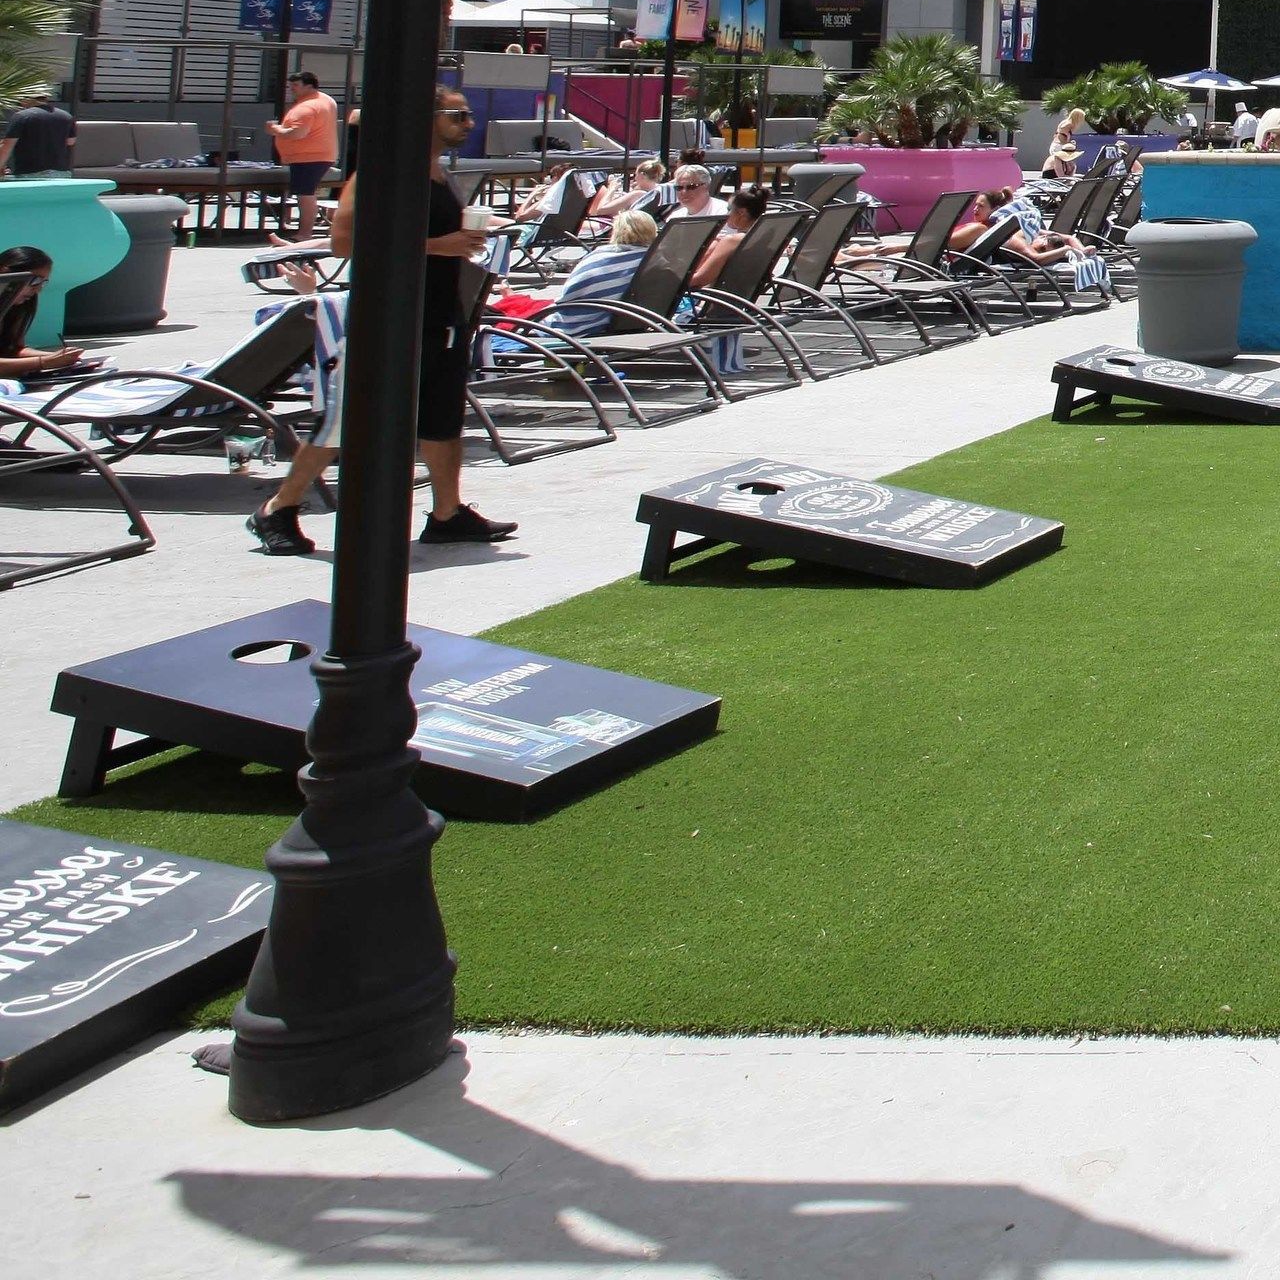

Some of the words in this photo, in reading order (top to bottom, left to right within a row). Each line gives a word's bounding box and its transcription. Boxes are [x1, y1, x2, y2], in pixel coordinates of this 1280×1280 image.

[422, 678, 468, 696] NEW
[445, 662, 552, 702] AMSTERDAM
[464, 683, 532, 706] VODKA
[44, 872, 122, 909] MASH
